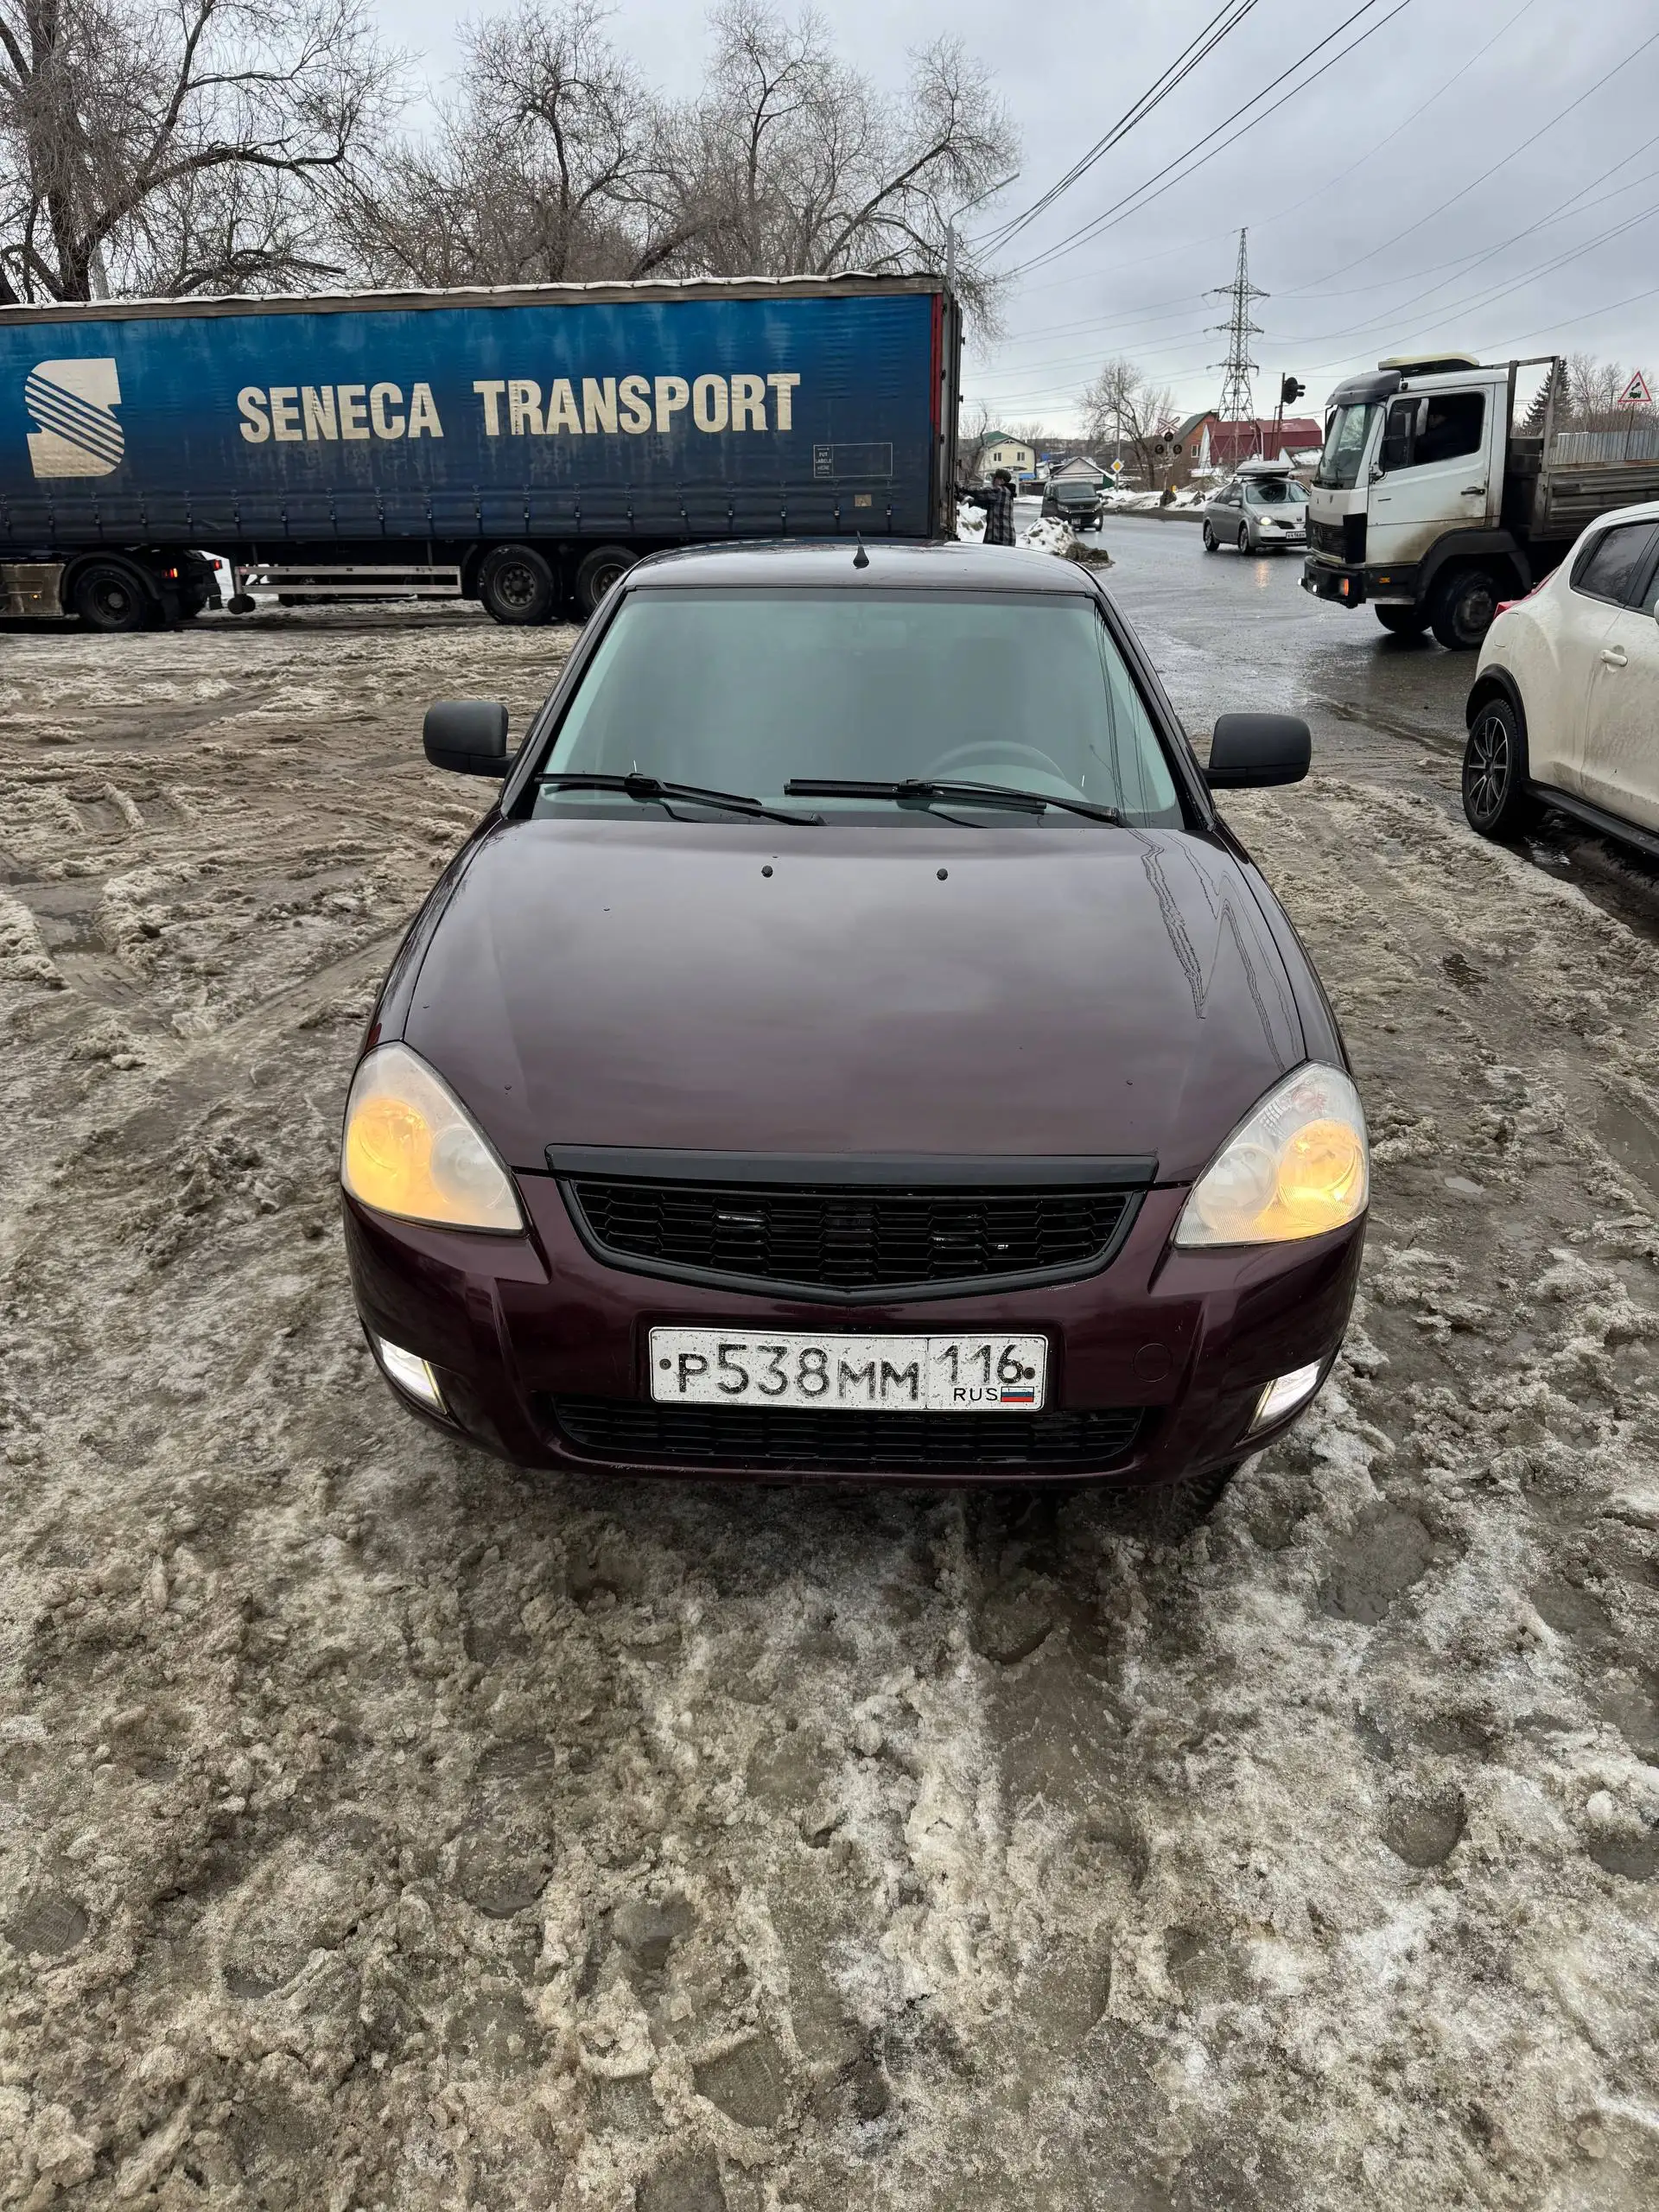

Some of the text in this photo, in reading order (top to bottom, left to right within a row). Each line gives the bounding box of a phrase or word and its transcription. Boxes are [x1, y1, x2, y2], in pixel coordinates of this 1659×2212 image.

[237, 372, 801, 443] SENECA TRANSPORT
[934, 1344, 1024, 1384] 116
[953, 1387, 998, 1402] RUS
